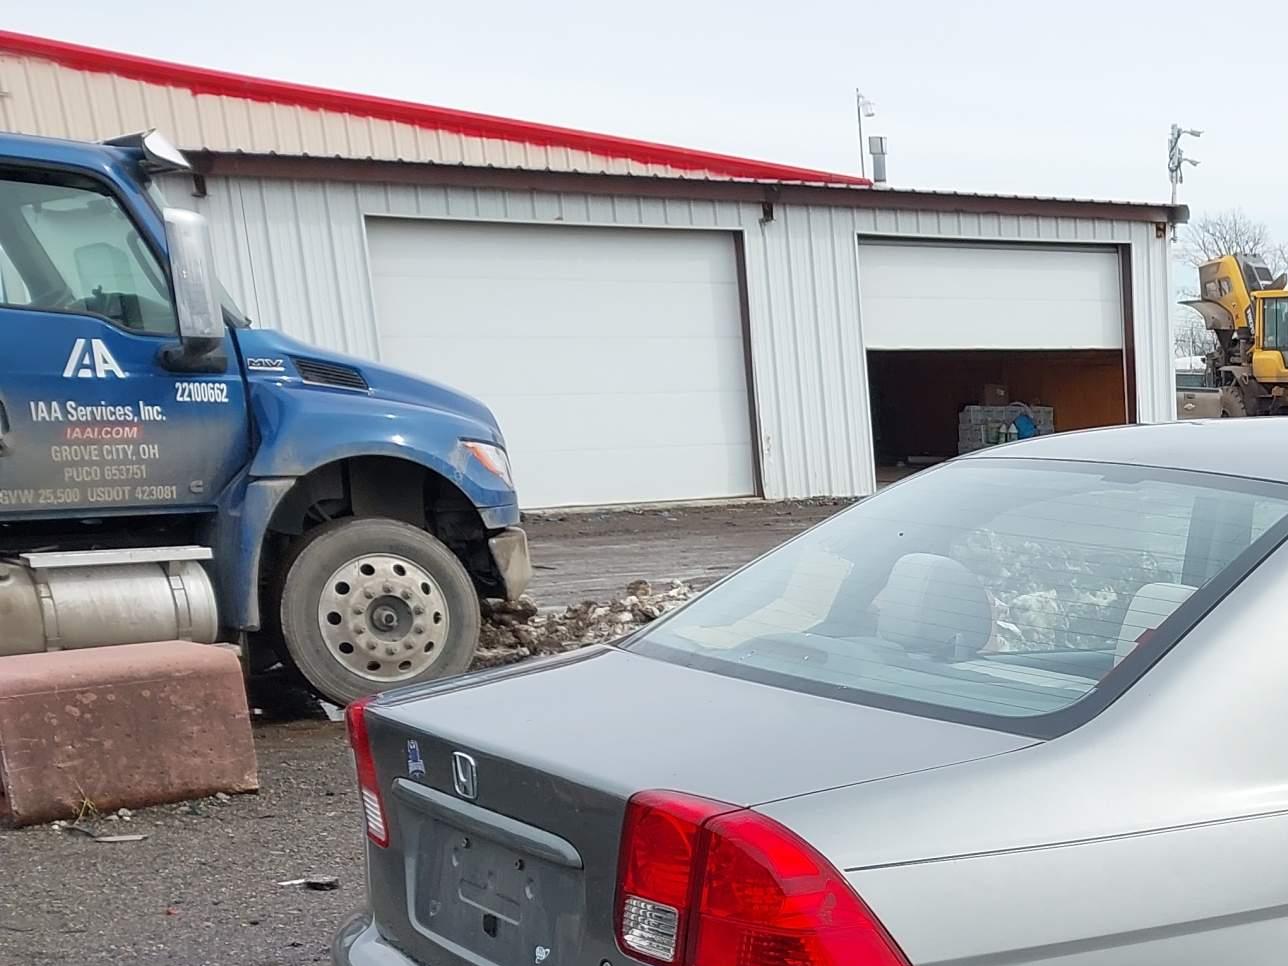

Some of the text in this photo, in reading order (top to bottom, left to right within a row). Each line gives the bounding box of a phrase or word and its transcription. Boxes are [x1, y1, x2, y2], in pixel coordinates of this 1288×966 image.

[175, 382, 229, 402] 22100662
[30, 400, 167, 422] IAA Services, Inc.
[66, 427, 138, 439] IAAI.COM
[51, 444, 159, 461] GROVE CITY, OH
[63, 464, 147, 482] PUCO 653751
[0, 485, 177, 505] GVW 25,500 USDOT 423081
